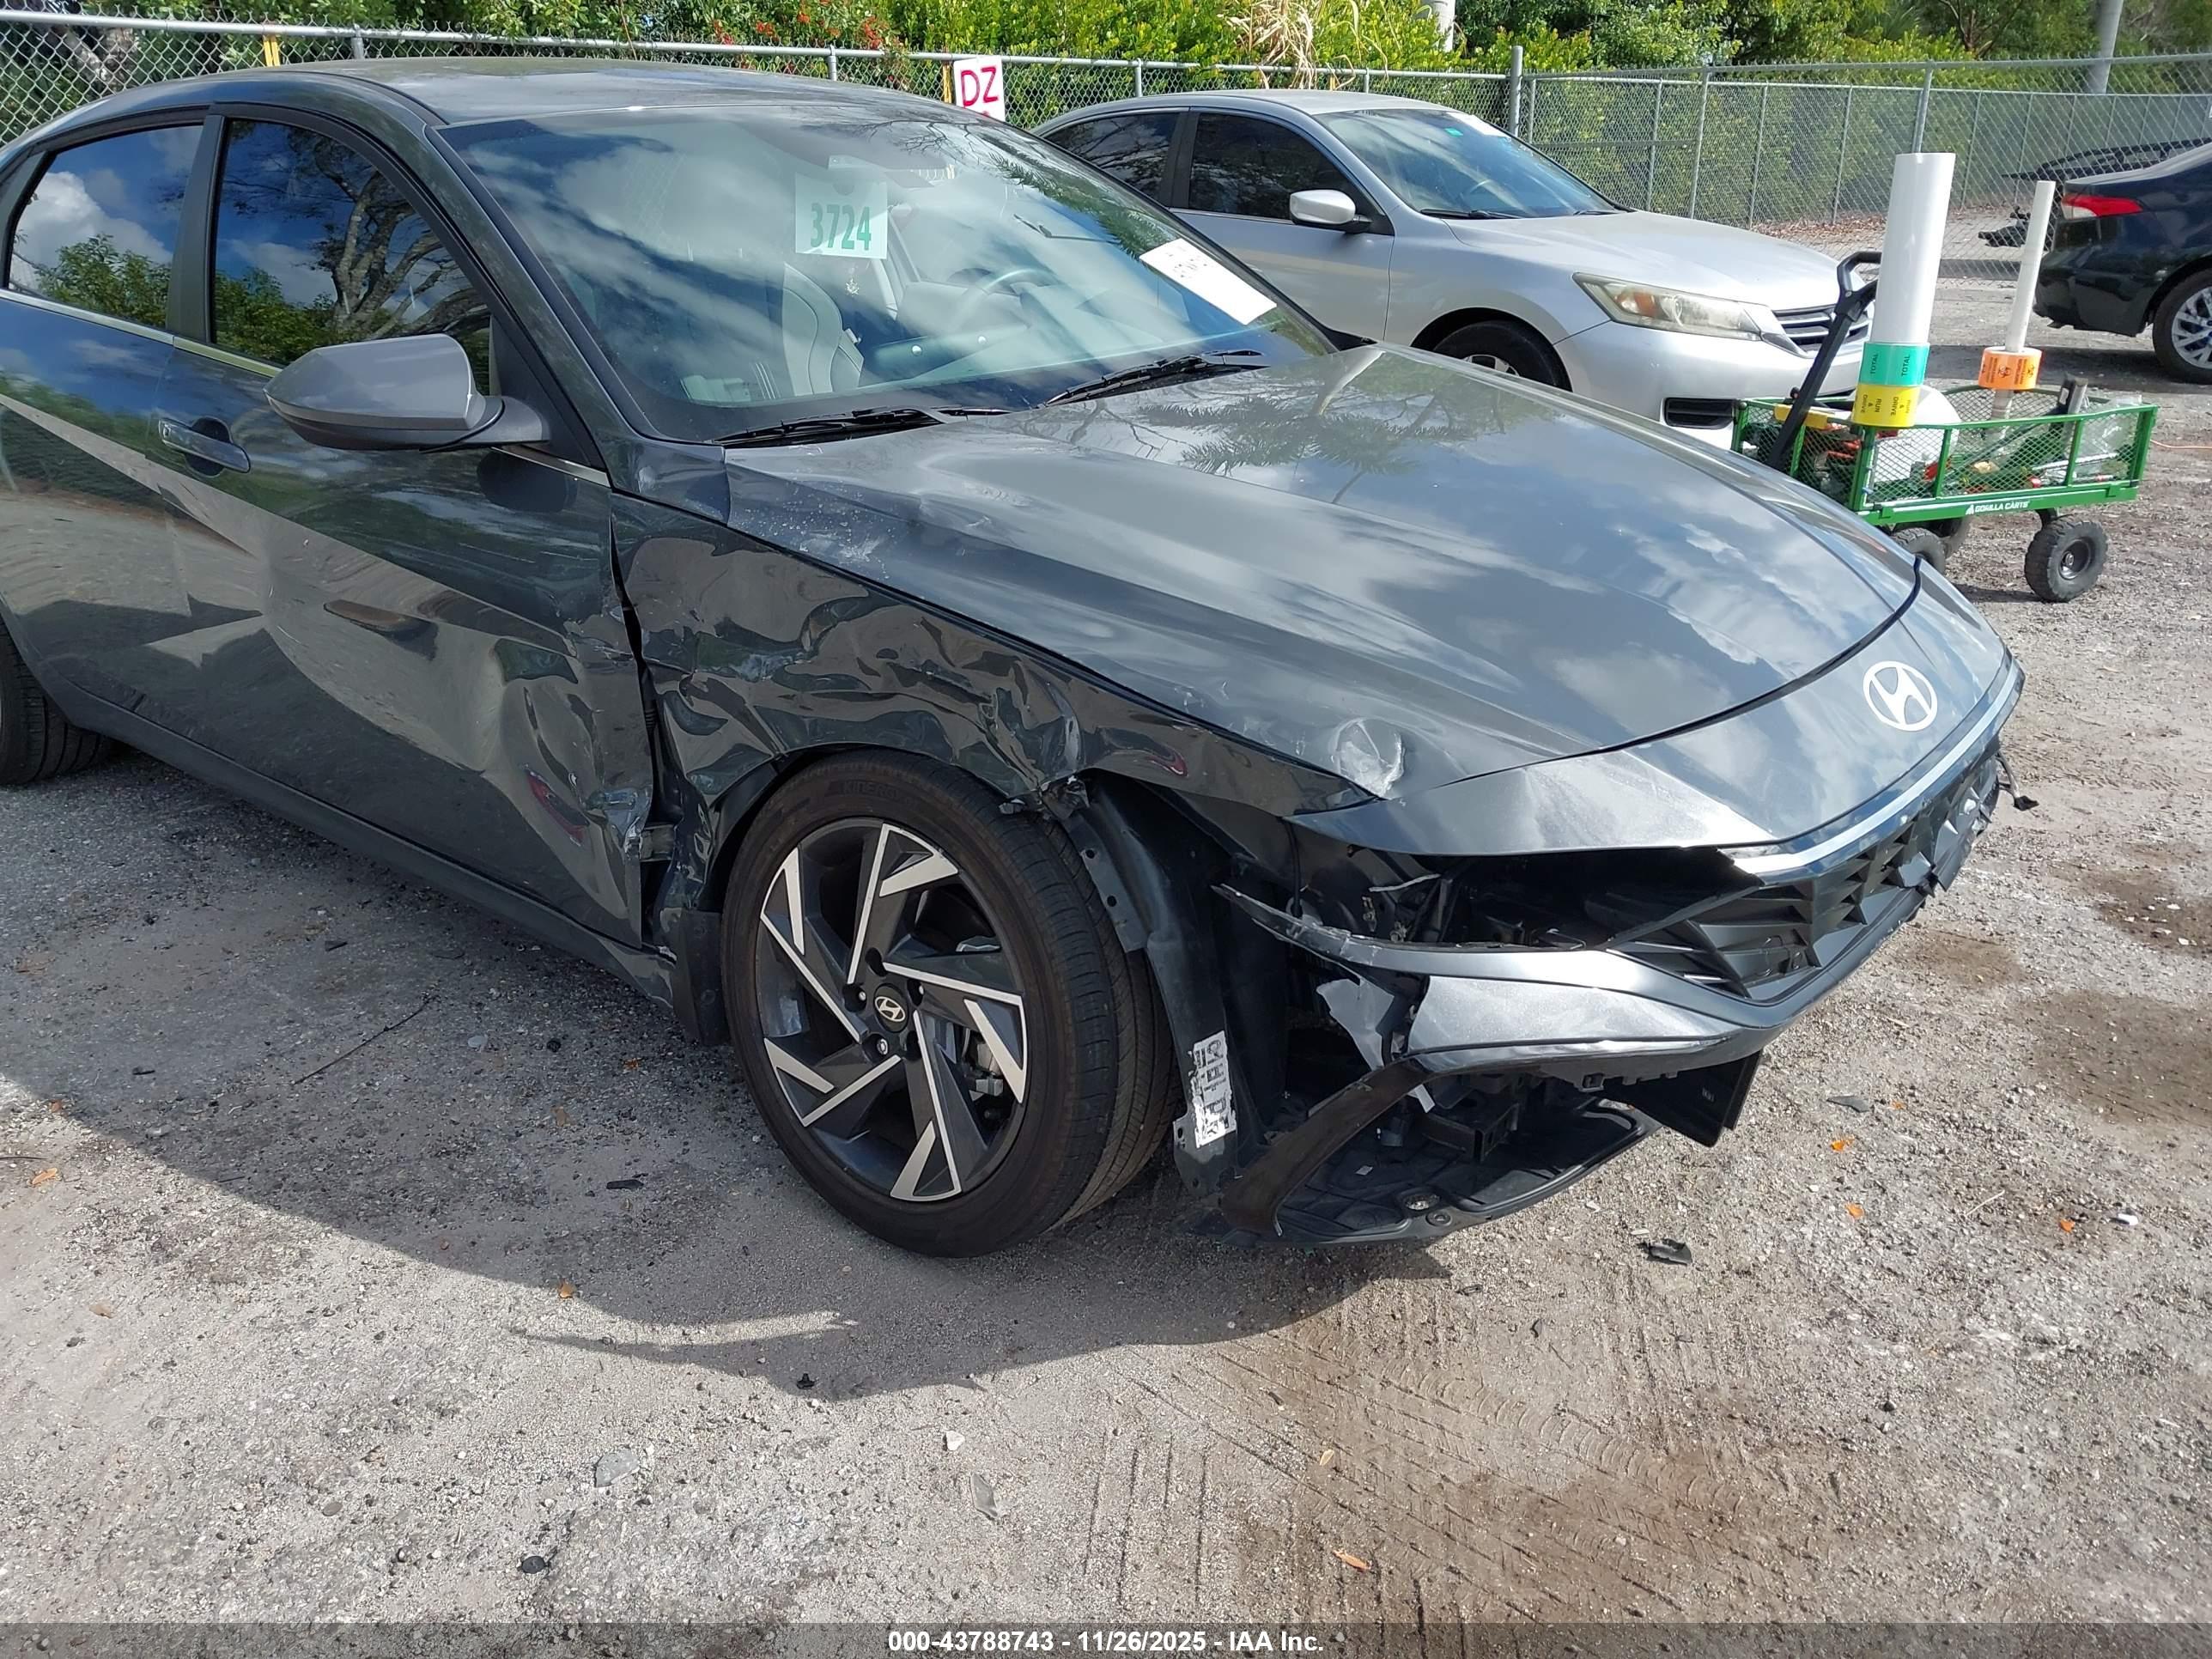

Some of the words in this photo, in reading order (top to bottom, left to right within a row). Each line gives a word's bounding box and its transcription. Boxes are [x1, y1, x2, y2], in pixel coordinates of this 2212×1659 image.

[960, 66, 999, 107] DZ
[810, 202, 872, 251] 3724
[1869, 353, 1879, 374] TOTAL
[1900, 355, 1911, 377] TOTAL
[1890, 397, 1899, 416] DRIVE
[1974, 502, 2004, 513] GORILLA
[2004, 501, 2028, 510] CARTS
